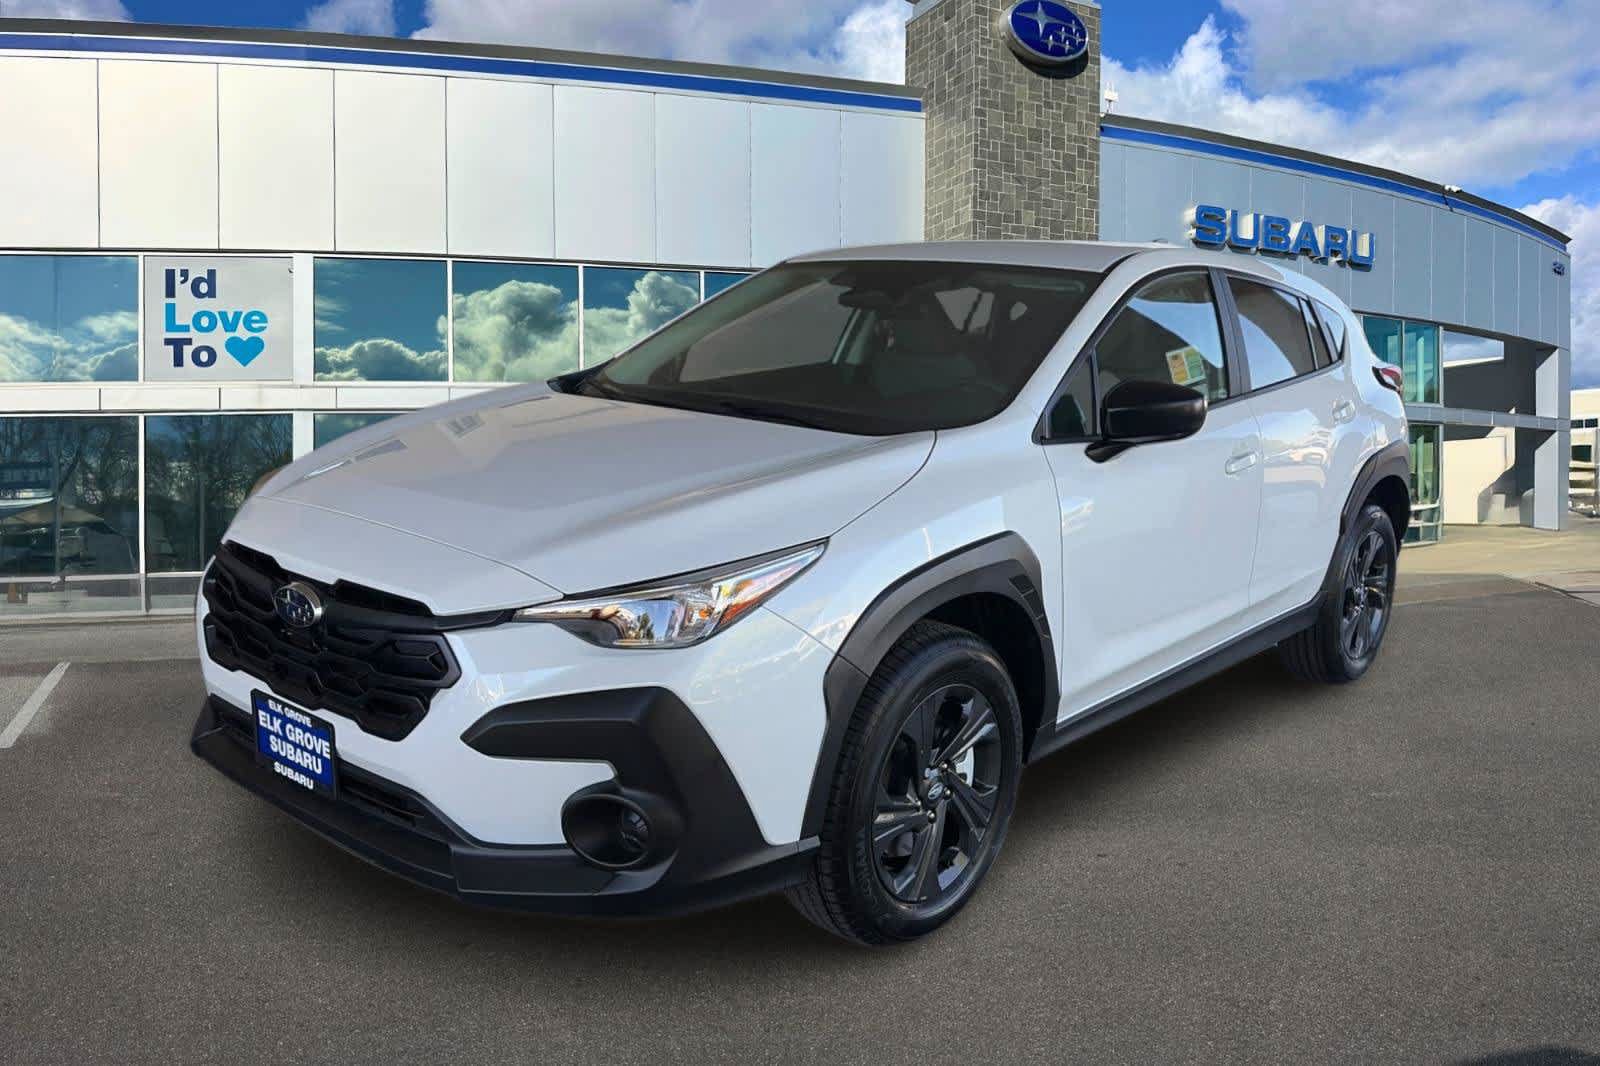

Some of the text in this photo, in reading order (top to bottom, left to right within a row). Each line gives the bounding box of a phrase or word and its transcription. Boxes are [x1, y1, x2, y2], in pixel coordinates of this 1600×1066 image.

[1193, 204, 1376, 267] SUBARU
[165, 268, 217, 299] I'd
[165, 302, 269, 333] Love
[164, 337, 217, 368] To
[268, 699, 312, 728] ELK GROVE
[258, 709, 331, 760] ELK GROVE
[269, 734, 322, 774] SUBARU
[273, 761, 314, 790] SUBARU
